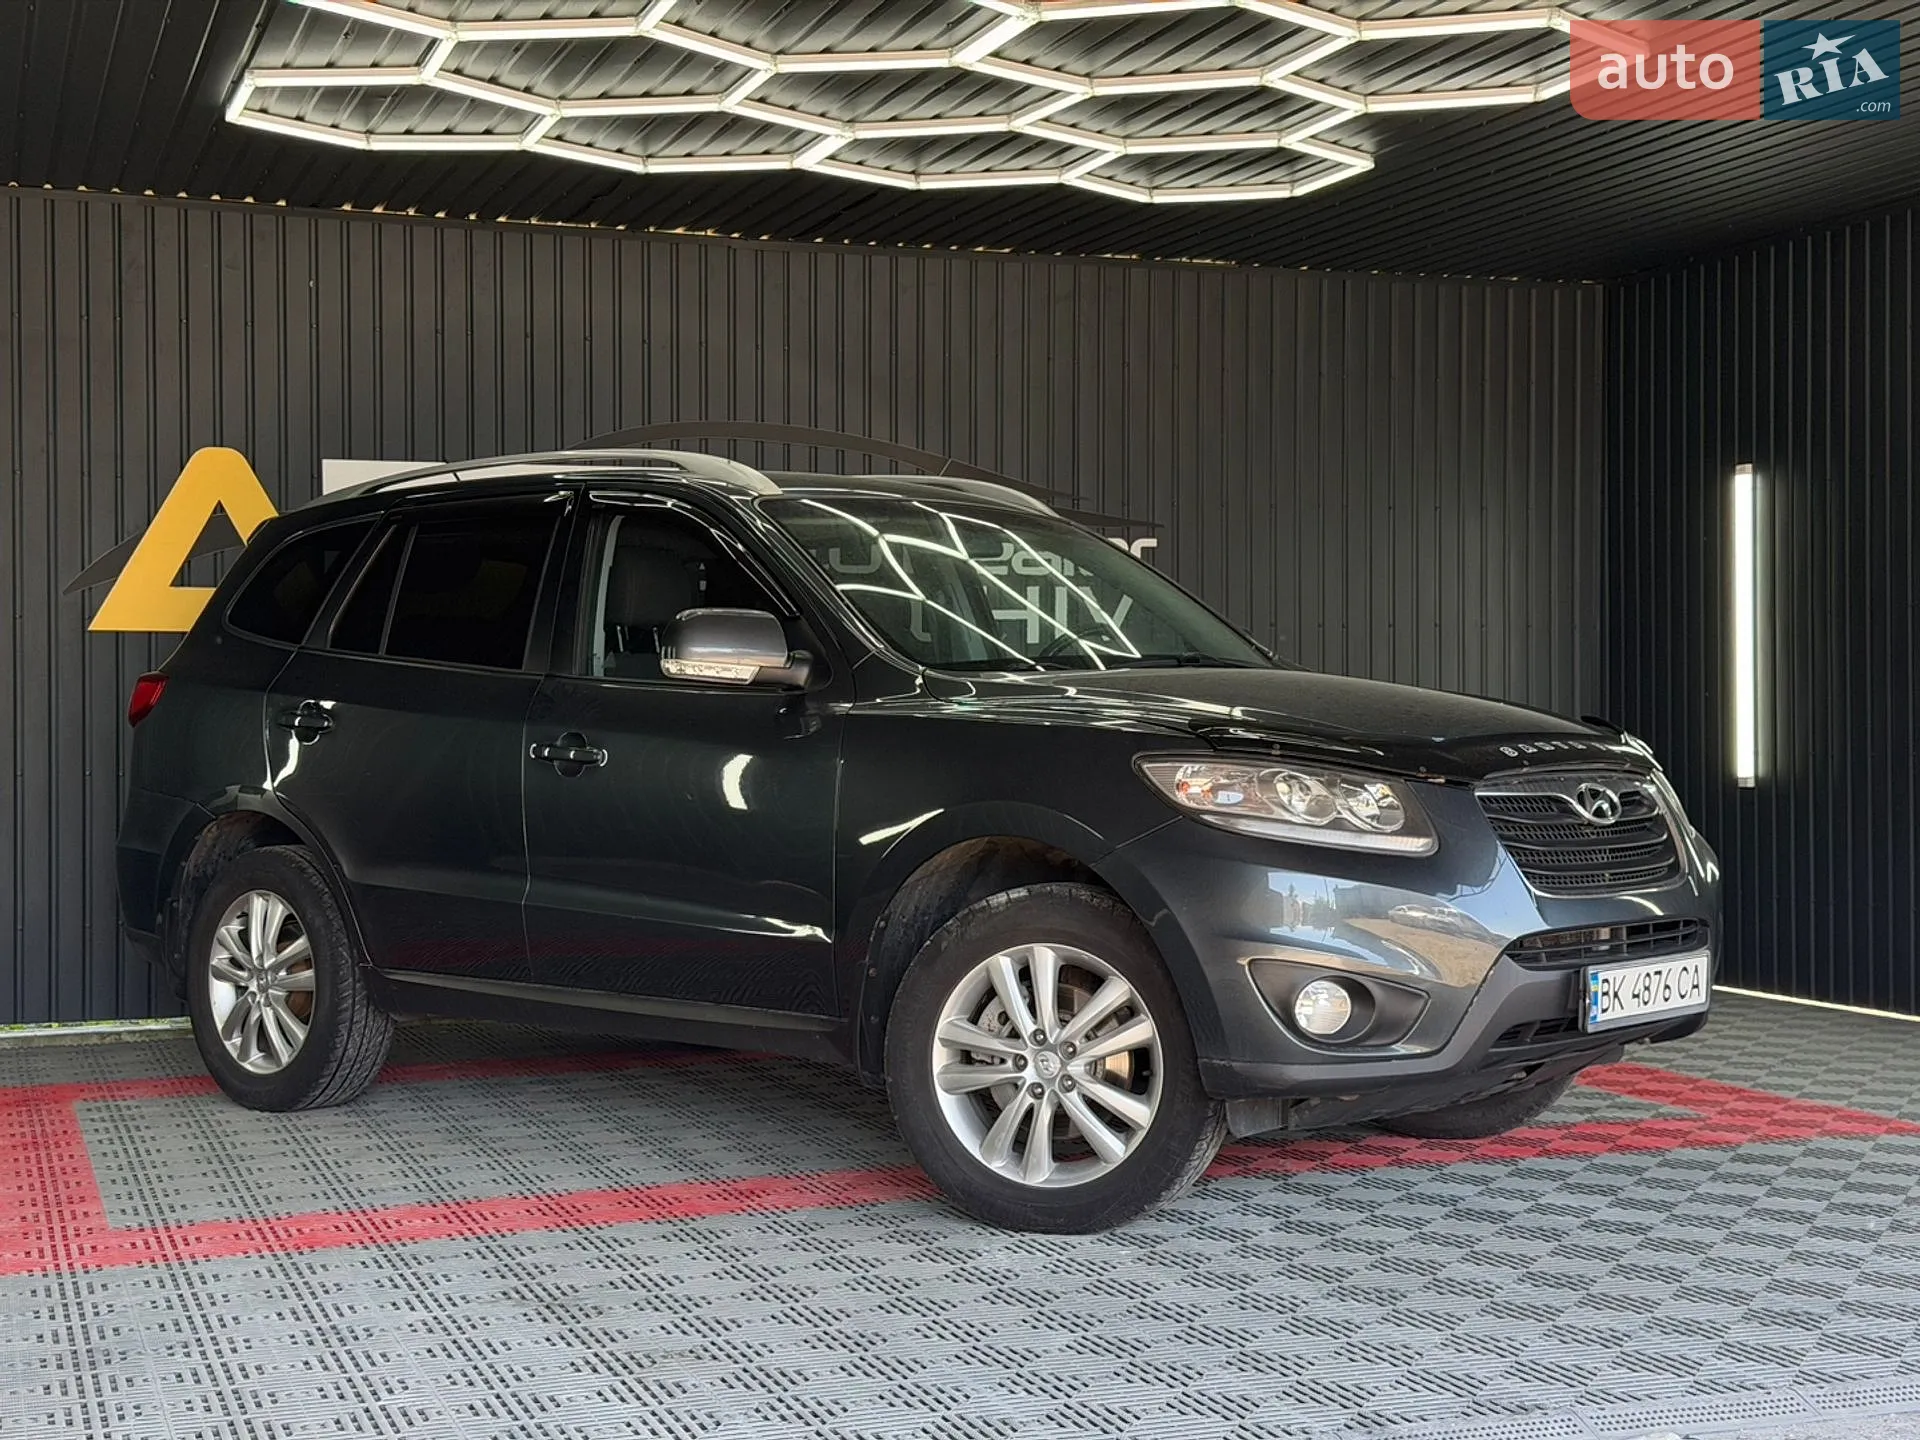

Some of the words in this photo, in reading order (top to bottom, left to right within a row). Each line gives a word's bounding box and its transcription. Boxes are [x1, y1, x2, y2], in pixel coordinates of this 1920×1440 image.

[1601, 975, 1626, 1014] BK
[1631, 968, 1672, 1008] 4876
[1677, 964, 1700, 1000] CA
